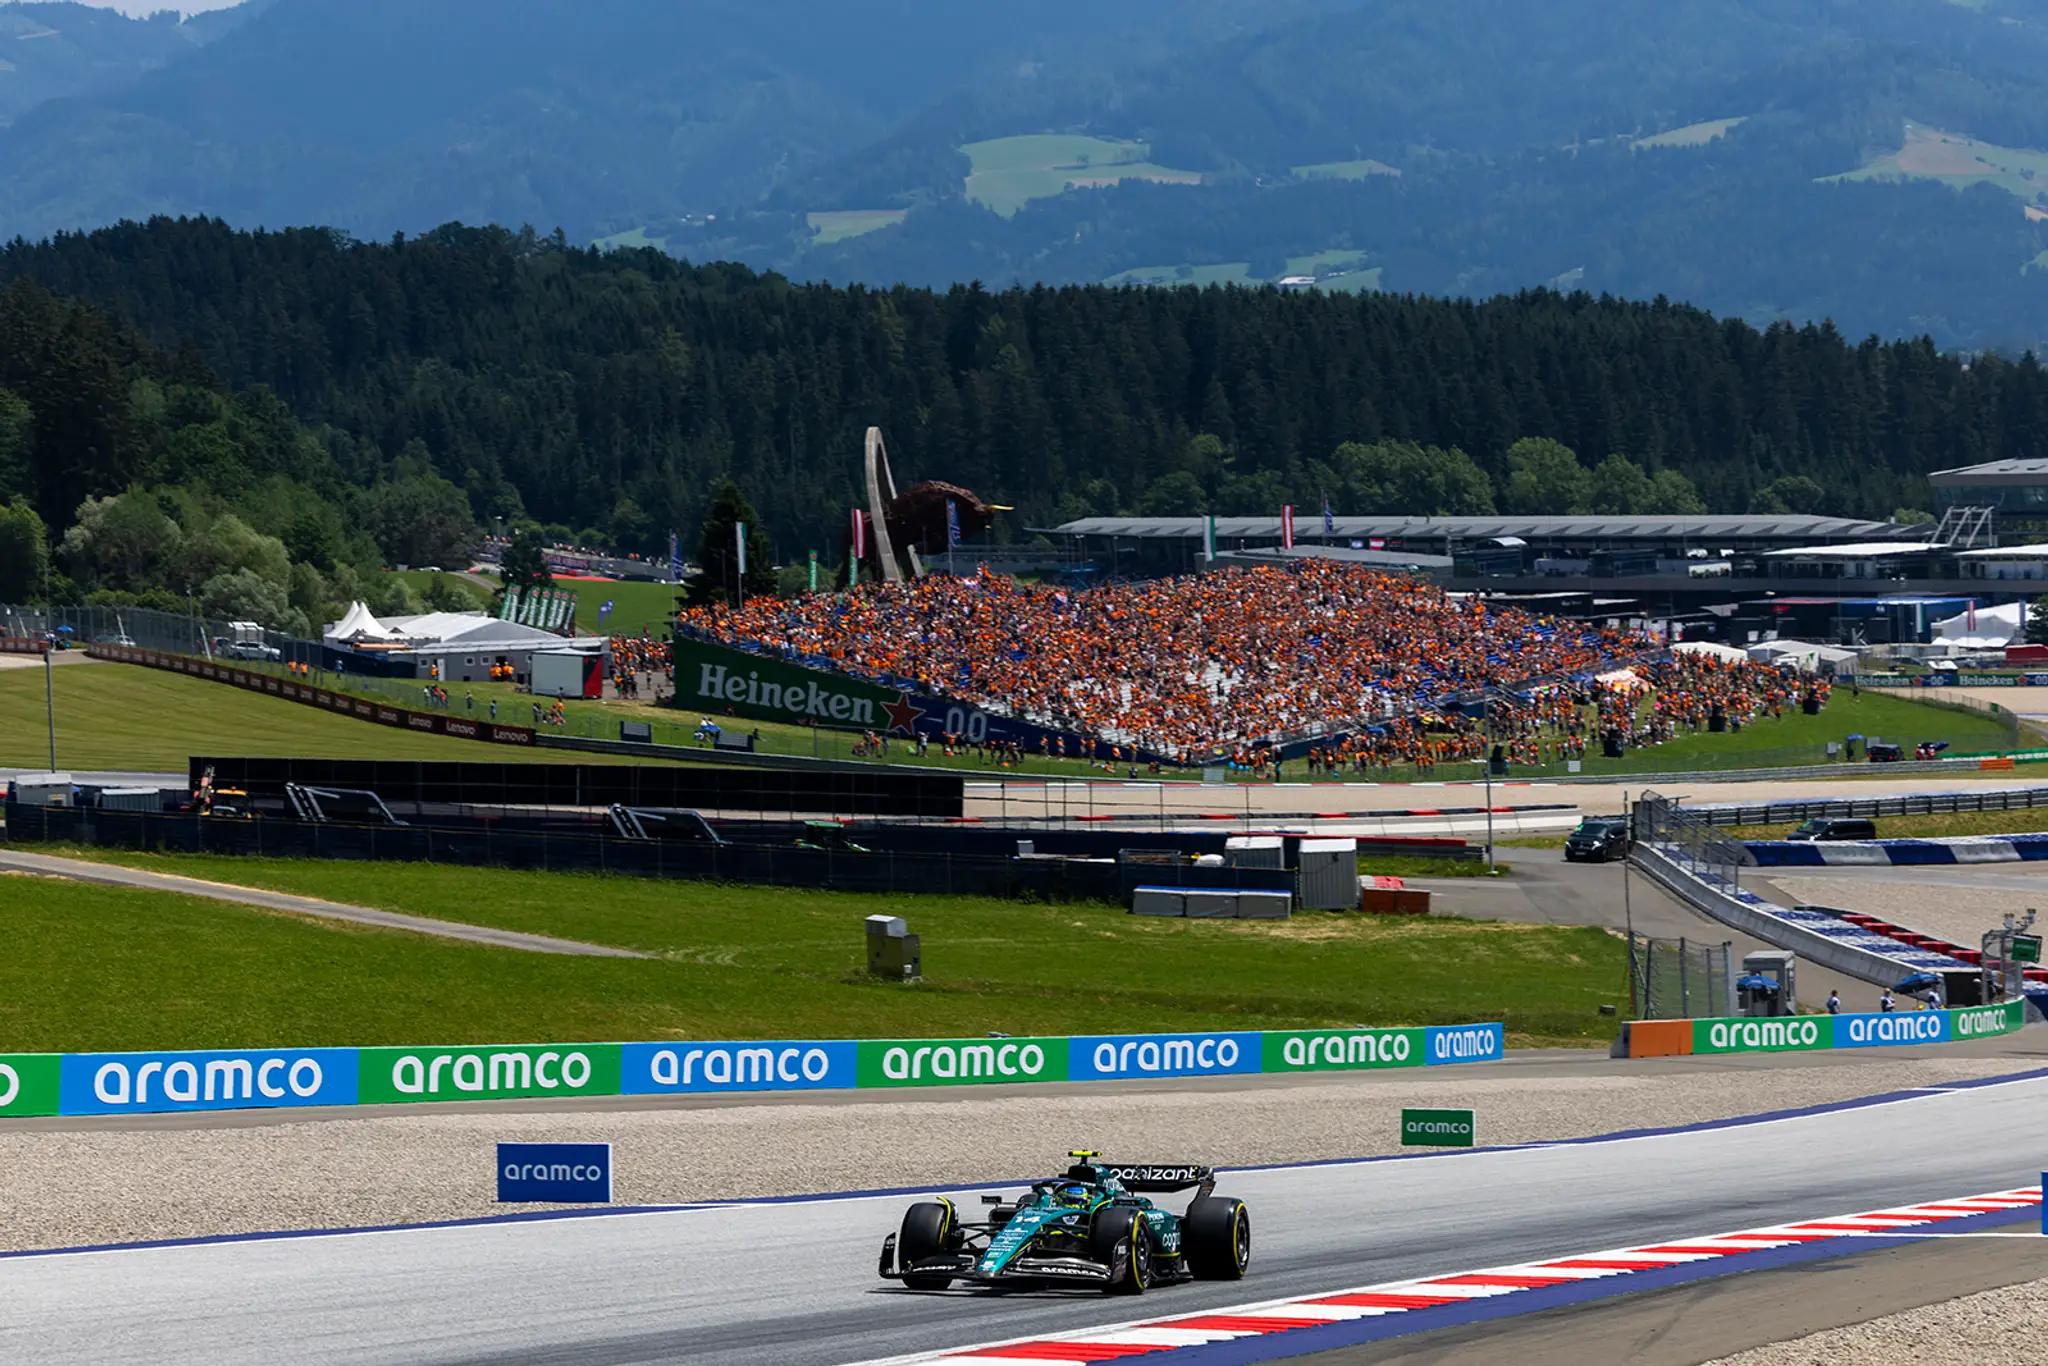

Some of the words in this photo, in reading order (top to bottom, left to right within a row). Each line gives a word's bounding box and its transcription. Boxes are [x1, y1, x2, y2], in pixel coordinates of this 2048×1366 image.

[697, 663, 875, 724] Heineken
[1855, 675, 1909, 686] Heineken
[1960, 675, 2014, 686] Heineken
[446, 721, 475, 735] Lenovo
[493, 728, 528, 742] Lenovo
[1710, 1022, 1818, 1047] aramco
[1849, 1016, 1941, 1041] aramco
[1958, 1009, 2006, 1035] aramco
[1094, 1040, 1239, 1072] aramco
[1284, 1035, 1410, 1065] aramco
[1435, 1030, 1494, 1058] aramco
[393, 1053, 591, 1093] aramco
[651, 1049, 829, 1084] aramco
[883, 1045, 1044, 1079] aramco
[94, 1059, 322, 1104] aramco
[1406, 1122, 1470, 1134] aramco
[505, 1164, 601, 1181] aramco
